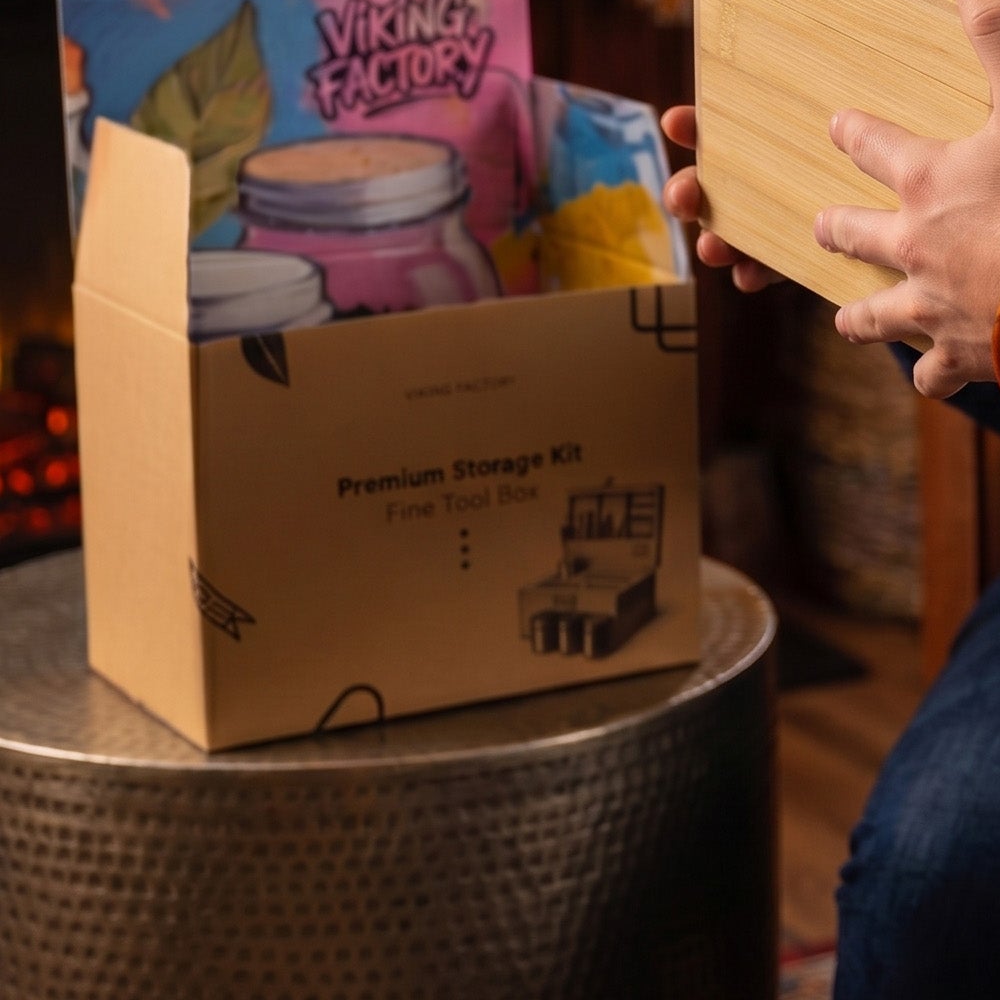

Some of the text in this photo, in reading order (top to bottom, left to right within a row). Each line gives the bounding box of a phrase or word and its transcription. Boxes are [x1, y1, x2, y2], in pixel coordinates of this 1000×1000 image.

[306, 26, 496, 120] FACTORY
[337, 442, 583, 498] Premium Storage Kit
[386, 482, 540, 523] Fine Tool Box
